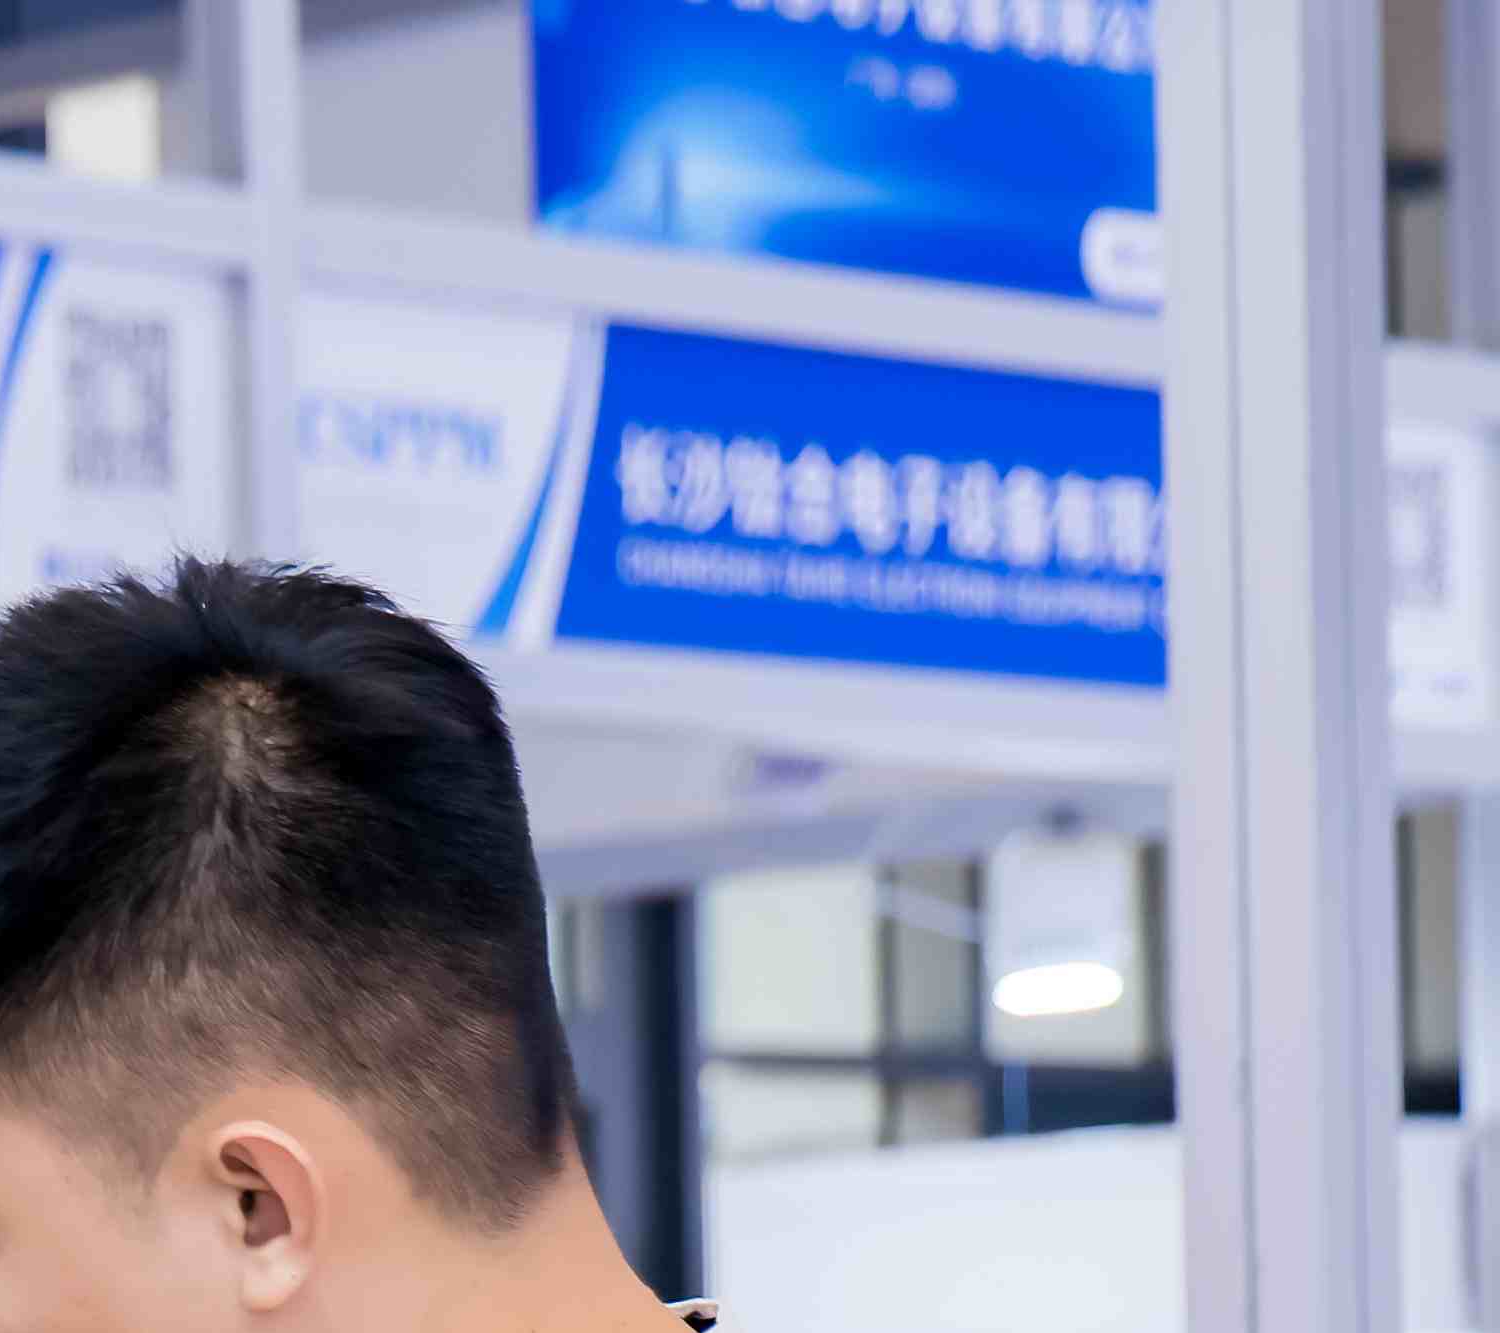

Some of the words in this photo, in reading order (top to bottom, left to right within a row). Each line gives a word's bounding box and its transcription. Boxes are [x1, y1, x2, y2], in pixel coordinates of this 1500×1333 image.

[614, 420, 1164, 577] 长沙钛合电子设备有限
